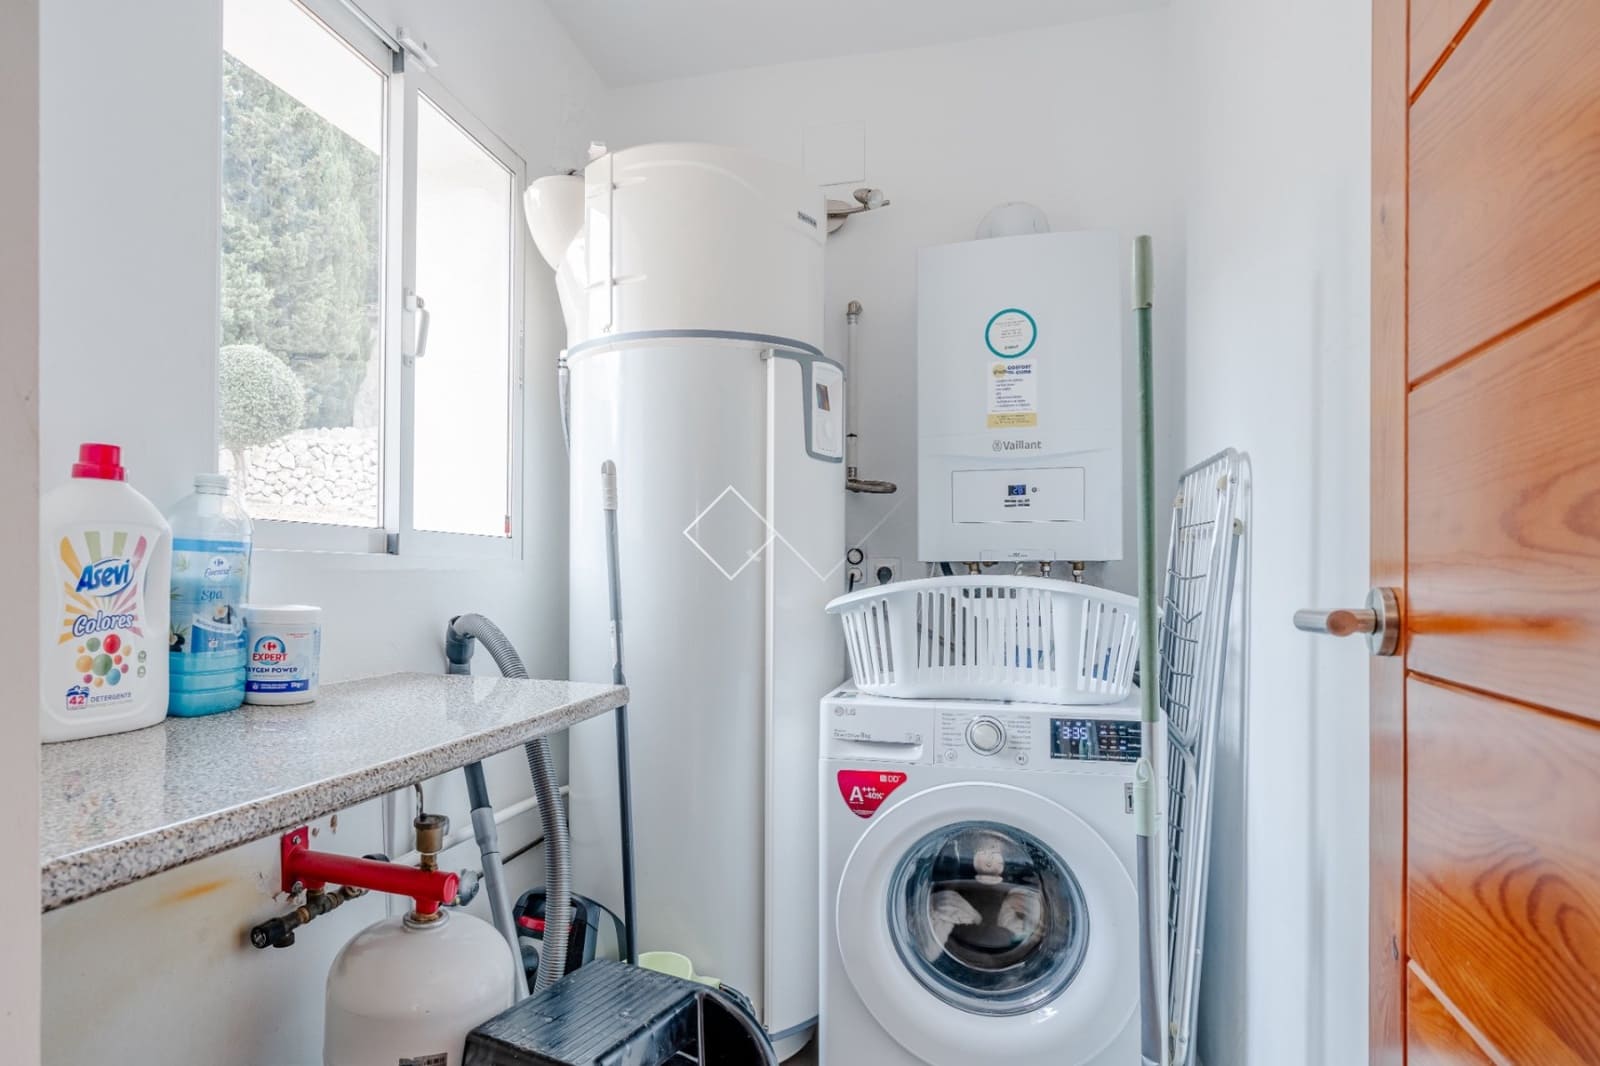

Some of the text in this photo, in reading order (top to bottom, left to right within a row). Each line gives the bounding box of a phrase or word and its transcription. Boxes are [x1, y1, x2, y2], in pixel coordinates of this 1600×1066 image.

[1003, 440, 1042, 450] Vaillant
[76, 559, 130, 593] Asevi
[73, 610, 134, 637] Colores
[252, 652, 288, 661] EXPERT
[69, 695, 84, 705] 42
[845, 706, 857, 716] LG
[1062, 726, 1088, 740] 3:35
